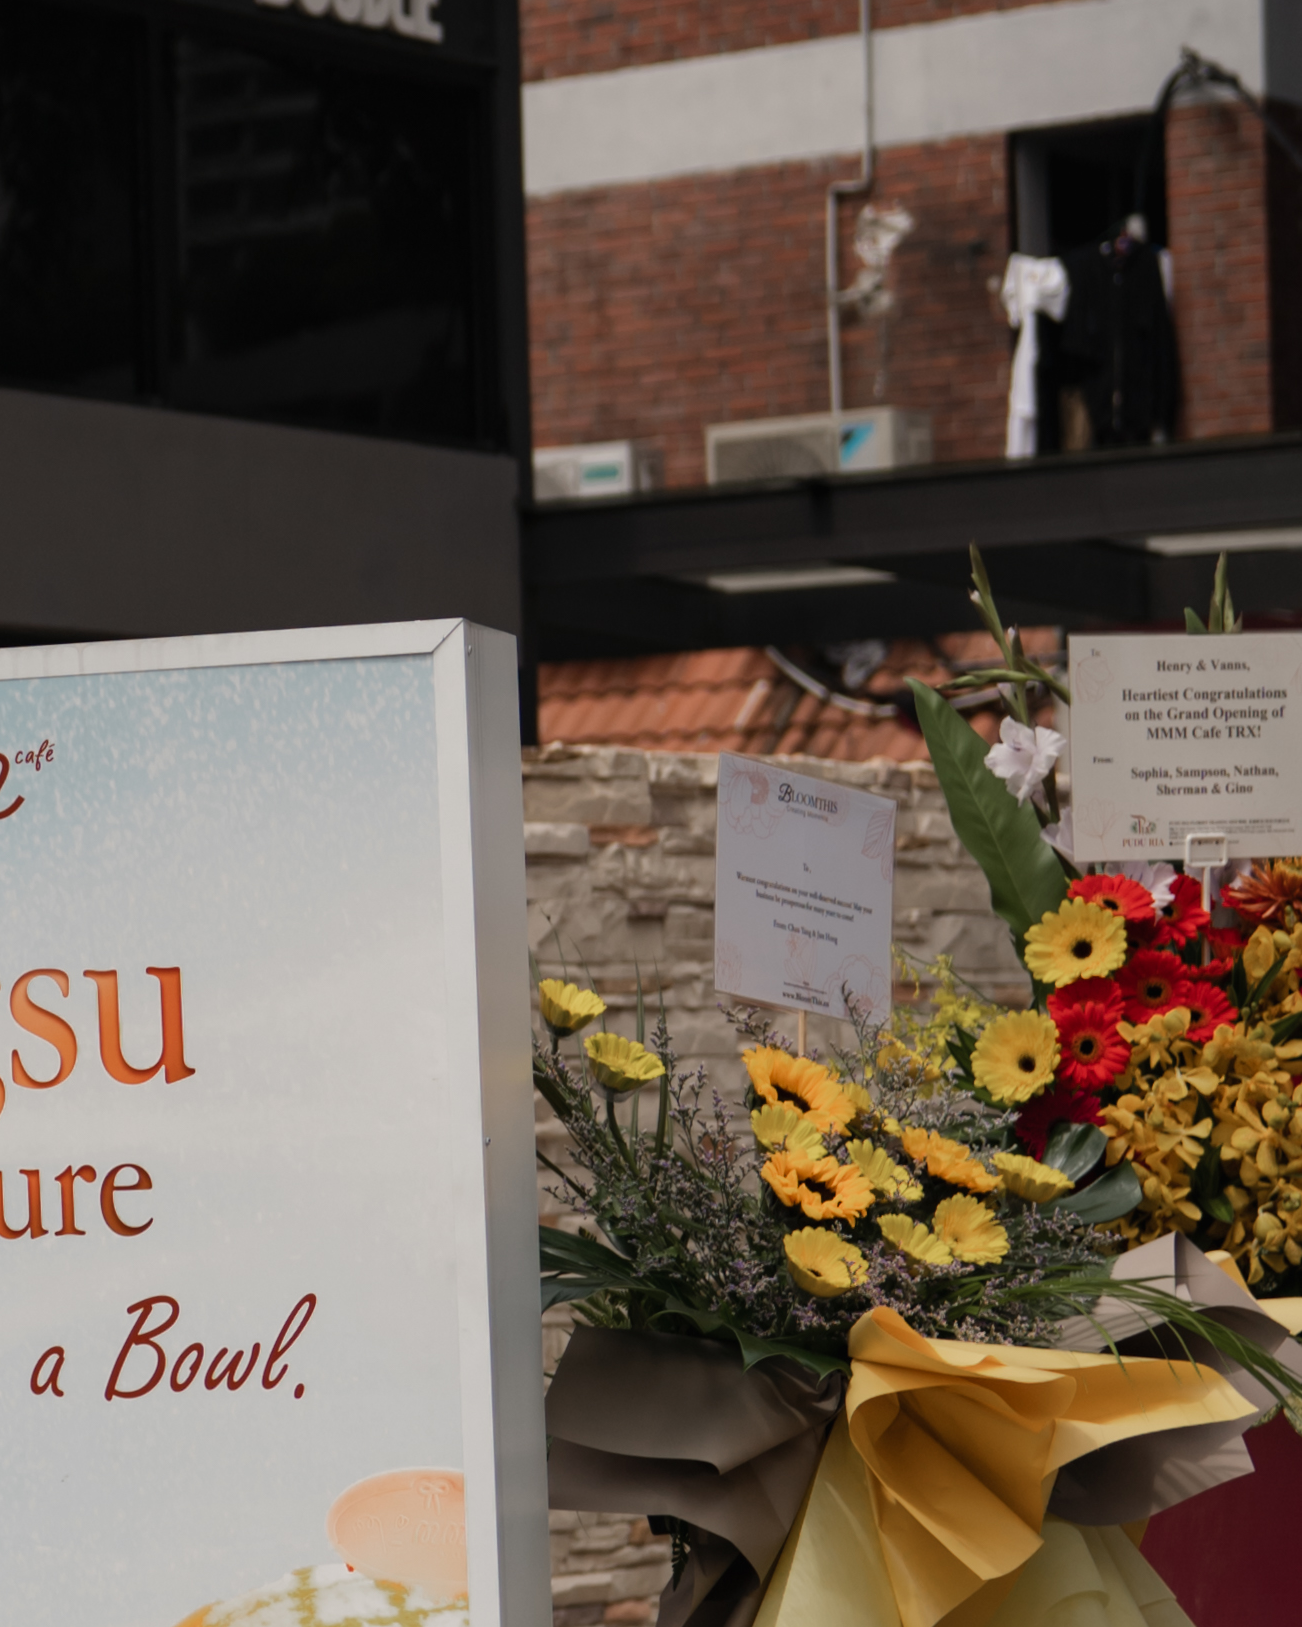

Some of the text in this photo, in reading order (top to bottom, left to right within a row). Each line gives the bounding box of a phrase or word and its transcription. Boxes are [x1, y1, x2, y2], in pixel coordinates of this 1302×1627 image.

[1156, 660, 1192, 674] Henry
[1196, 659, 1207, 672] &
[1122, 686, 1287, 703] Heartiest Congratulations
[1125, 705, 1286, 722] on the Grand Opening of
[1147, 725, 1261, 740] MMM Cafe TRX!
[1131, 765, 1279, 782] Sophia, Sampson, Nathan,
[1156, 782, 1253, 797] Sherman & Gino
[30, 1346, 66, 1397] a
[104, 1293, 317, 1401] Bowl.
